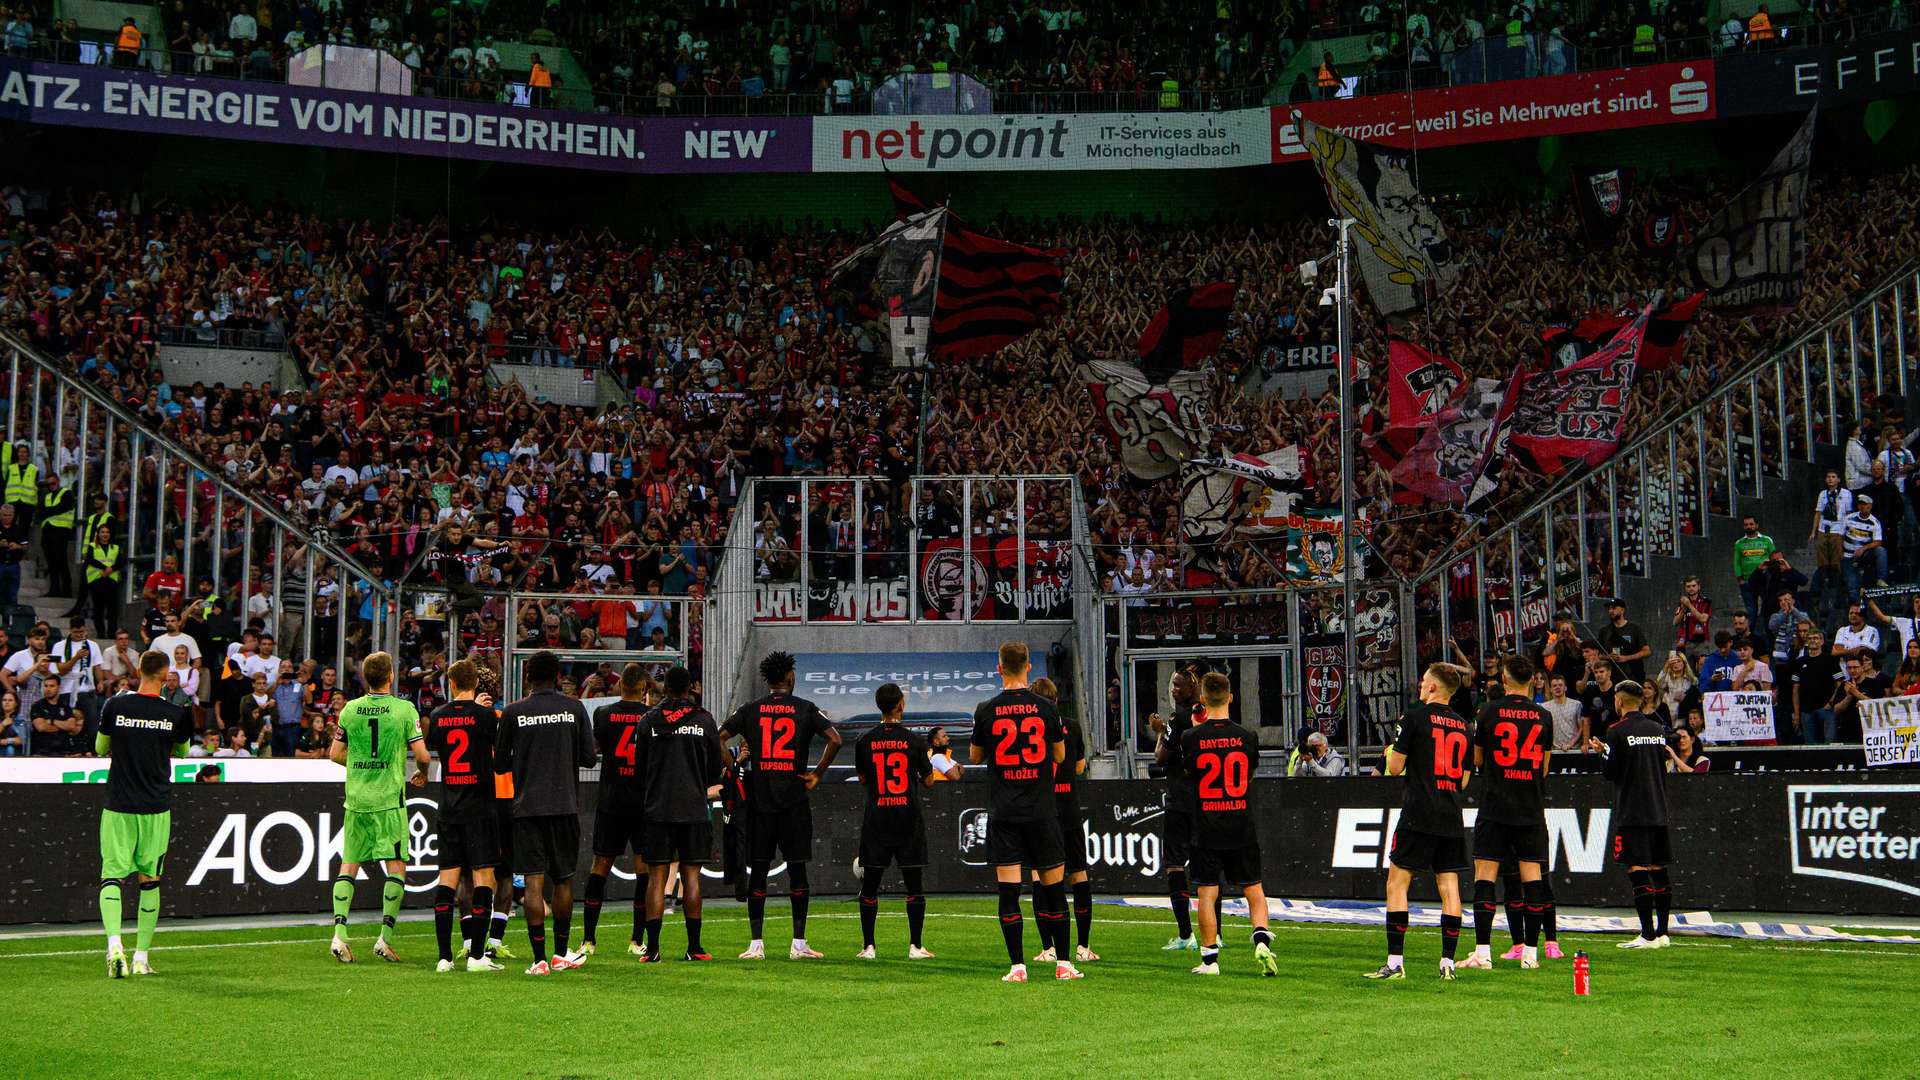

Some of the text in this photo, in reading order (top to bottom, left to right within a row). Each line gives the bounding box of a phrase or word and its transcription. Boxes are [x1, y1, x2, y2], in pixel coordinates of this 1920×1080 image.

[1, 71, 646, 160] ATZ. ENERGIE VOM NIEDERRHEIN.
[1415, 110, 1457, 133] weil
[1462, 105, 1494, 129] Sie
[1500, 97, 1601, 124] Mehrwert
[1607, 90, 1658, 114] sind.
[1100, 126, 1227, 140] IT-Services aus
[841, 119, 1069, 168] netpoint
[1086, 142, 1241, 160] Mönchengladbach
[813, 685, 871, 695] die
[1311, 678, 1340, 690] BAYER
[357, 706, 380, 716] BAYER
[759, 704, 796, 715] BAYER 04
[995, 703, 1038, 716] BAYER 04
[1314, 703, 1332, 715] 04
[1708, 693, 1730, 716] 4
[1743, 706, 1767, 719] TAH
[438, 717, 464, 727] BAYER
[517, 711, 575, 728] Barmenia
[610, 713, 636, 723] BAYER
[1430, 714, 1457, 729] BAYER
[1499, 708, 1540, 720] BAYER 04
[1860, 698, 1920, 729] VICT
[115, 715, 173, 732] Barmenia
[367, 717, 379, 759] 1
[614, 725, 637, 766] 4
[758, 716, 796, 760] 12
[871, 740, 908, 751] BAYER 04
[991, 716, 1047, 766] 23
[1200, 737, 1243, 750] BAYER 04
[1493, 721, 1544, 770] 34
[1866, 735, 1887, 746] can
[1894, 730, 1917, 745] have
[446, 728, 472, 773] 2
[1431, 727, 1468, 779] 10
[1866, 745, 1907, 763] JERSEY
[871, 752, 909, 795] 13
[1004, 767, 1039, 781] HLOŽEK
[1196, 751, 1249, 799] 20
[1504, 769, 1533, 781] XHAKA
[1202, 800, 1247, 812] GRIMALDO
[1801, 790, 1887, 830] inter
[186, 810, 370, 886] AOK
